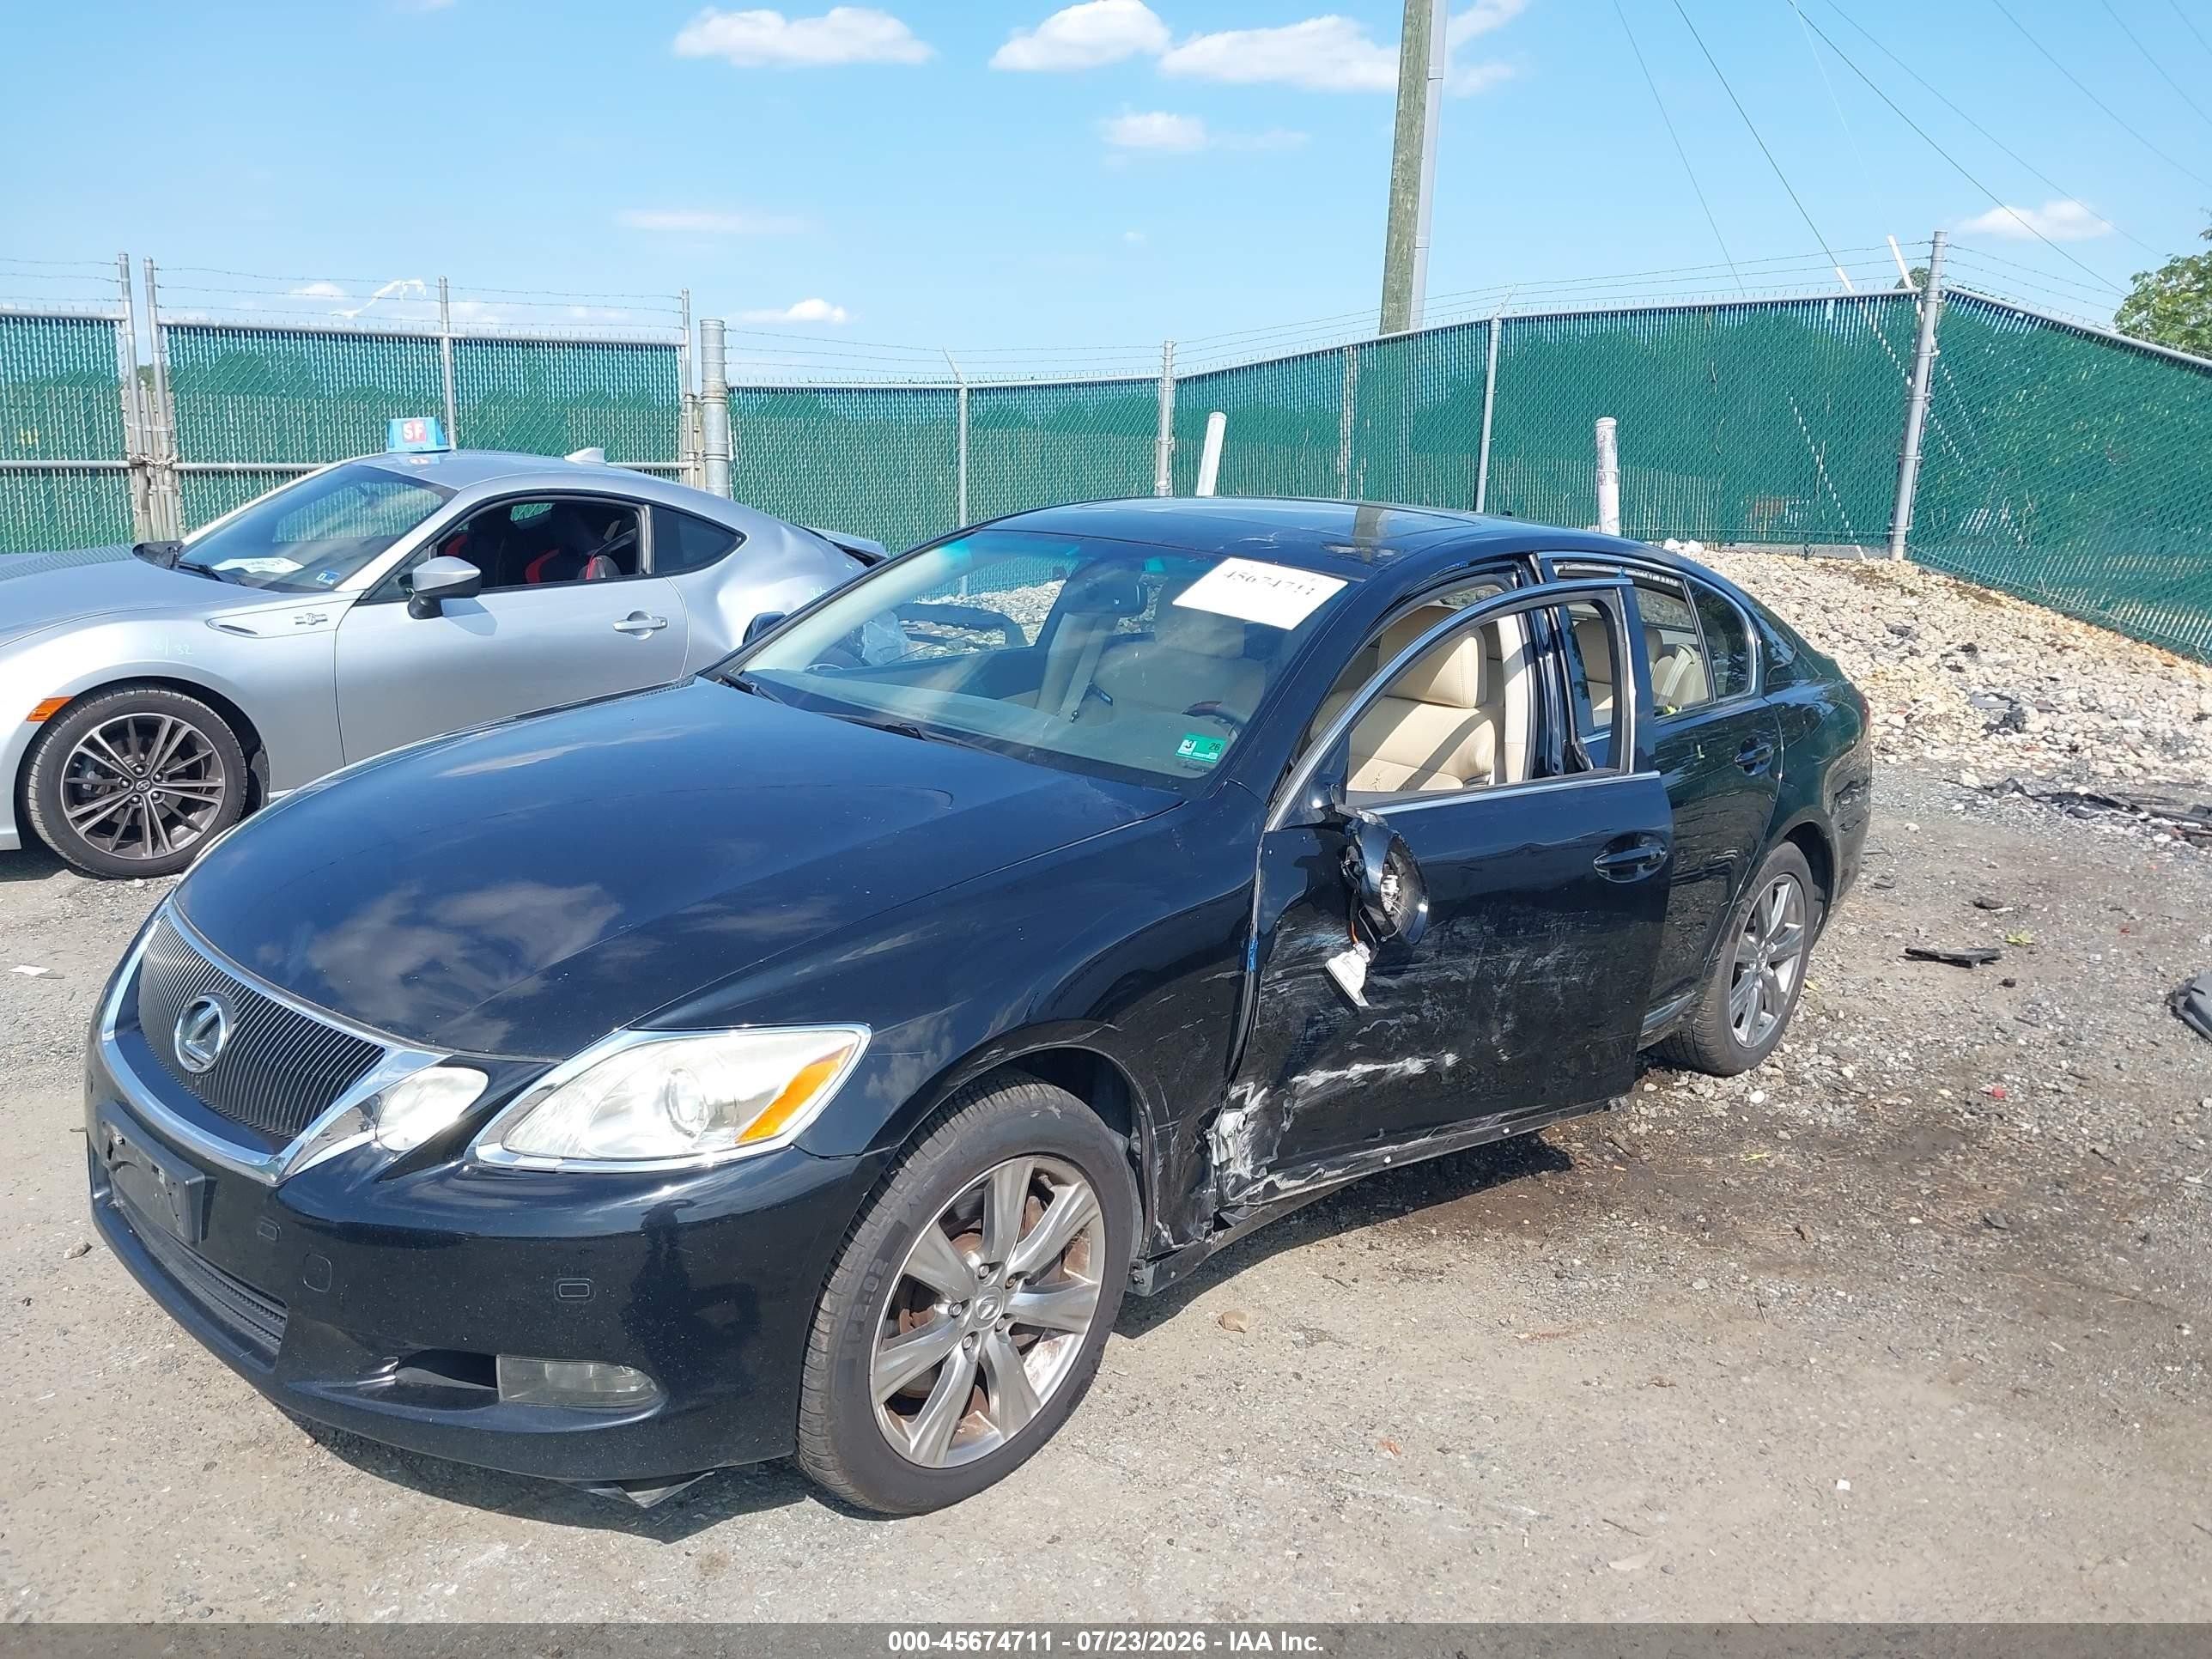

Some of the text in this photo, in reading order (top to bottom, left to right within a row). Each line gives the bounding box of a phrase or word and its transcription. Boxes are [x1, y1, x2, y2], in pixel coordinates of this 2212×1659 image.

[404, 422, 423, 441] SF
[1185, 739, 1194, 749] 3
[1209, 742, 1221, 751] 26
